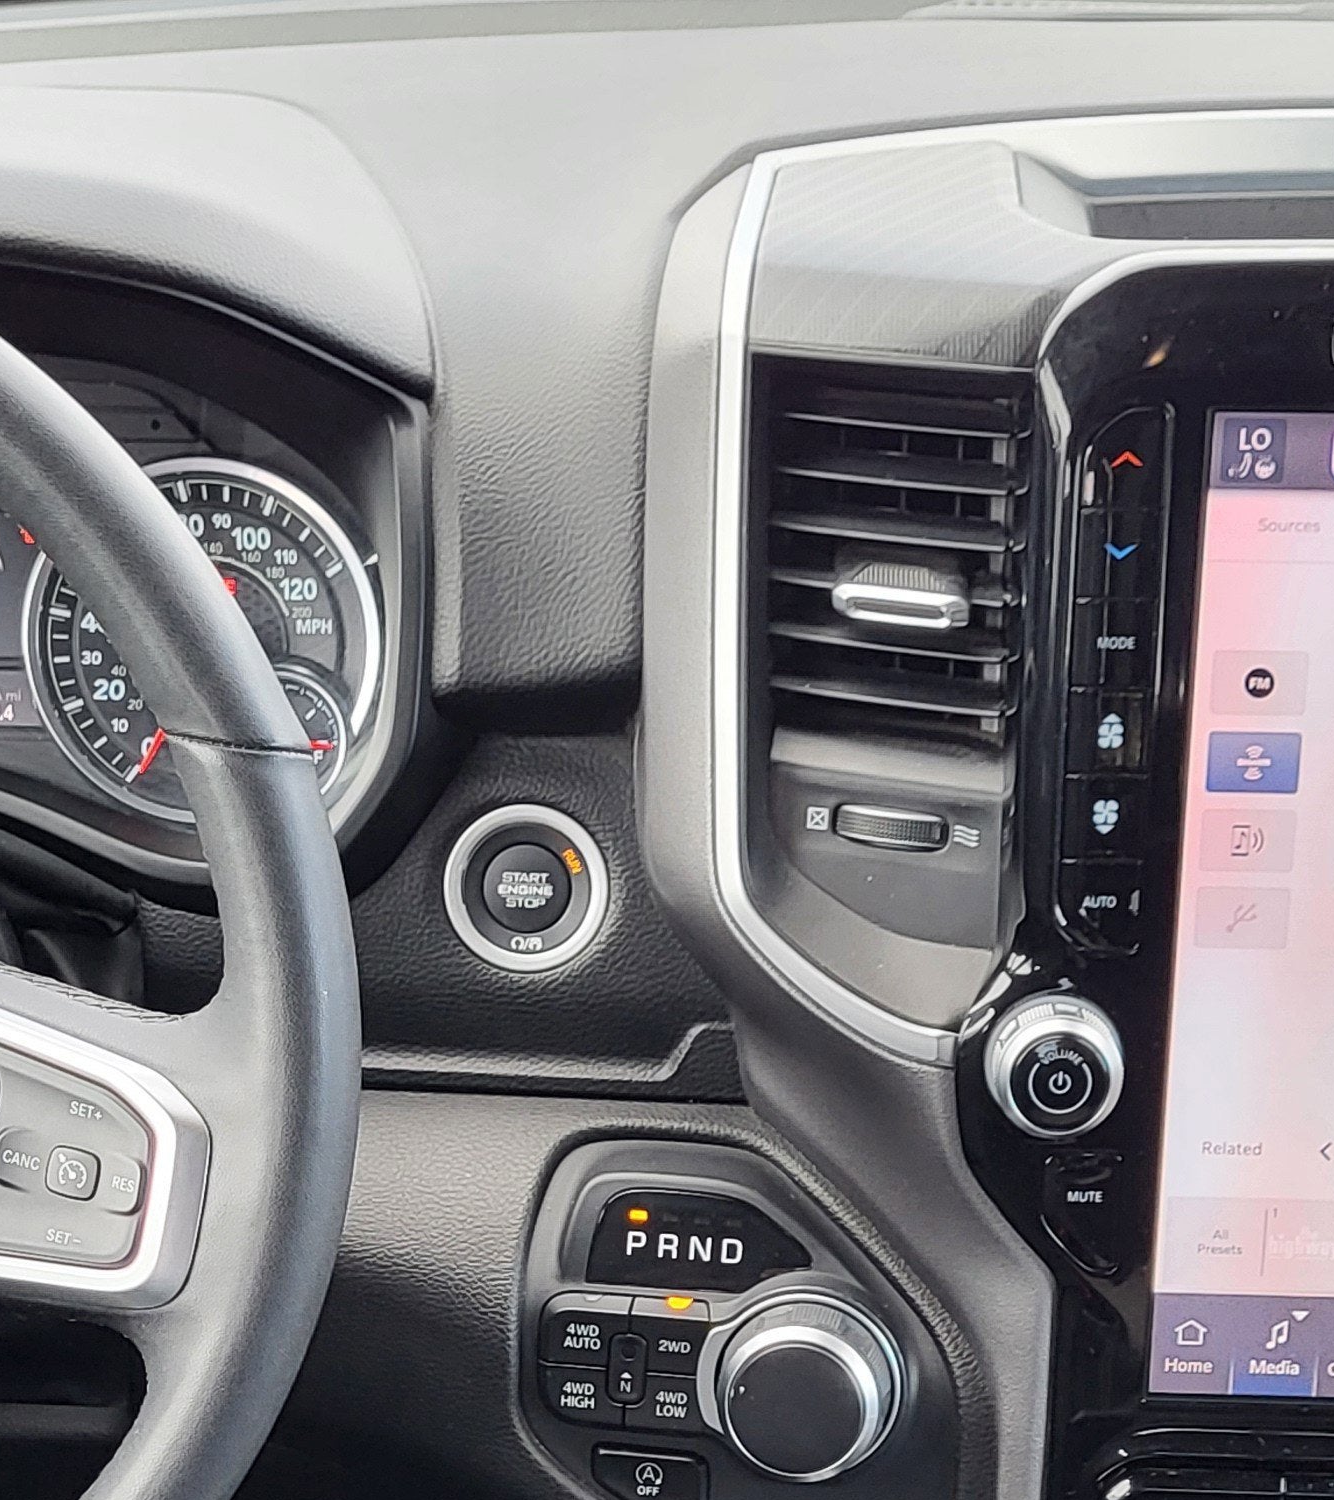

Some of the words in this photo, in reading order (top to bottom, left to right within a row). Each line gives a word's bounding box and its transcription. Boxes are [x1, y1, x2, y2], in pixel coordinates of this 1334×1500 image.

[1238, 427, 1273, 451] LO
[211, 513, 232, 529] 90
[1257, 517, 1322, 534] Sources
[231, 527, 271, 550] 100
[274, 549, 298, 565] 110
[279, 577, 318, 601] 120
[295, 618, 333, 635] MPH
[1097, 635, 1136, 651] MODE
[80, 650, 103, 666] 30
[110, 665, 127, 677] 40
[92, 678, 126, 701] 20
[1247, 676, 1272, 692] FM
[127, 698, 143, 712] 20
[110, 718, 130, 734] 10
[501, 871, 551, 884] START
[497, 883, 554, 897] ENGINE
[505, 897, 547, 909] STOP
[1081, 896, 1117, 909] AUTO
[69, 1100, 103, 1120] SET+
[1201, 1141, 1263, 1157] Related
[2, 1148, 41, 1173] CANC
[110, 1174, 137, 1195] RES
[1067, 1190, 1103, 1203] MUTE
[1213, 1229, 1229, 1241] All
[626, 1230, 647, 1256] P
[657, 1233, 679, 1259] R
[688, 1235, 713, 1262] N
[720, 1238, 744, 1265] D
[1197, 1243, 1243, 1256] Presets
[566, 1323, 600, 1338] 4WD
[563, 1336, 601, 1351] AUTO
[658, 1340, 691, 1355] 2WD
[1164, 1358, 1214, 1374] Home
[1249, 1360, 1300, 1376] Media
[562, 1382, 595, 1396] 4WD
[620, 1379, 632, 1394] N
[560, 1395, 595, 1410] HIGH
[655, 1391, 688, 1406] 4WD
[655, 1404, 688, 1419] LOW
[636, 1485, 660, 1498] OFF
